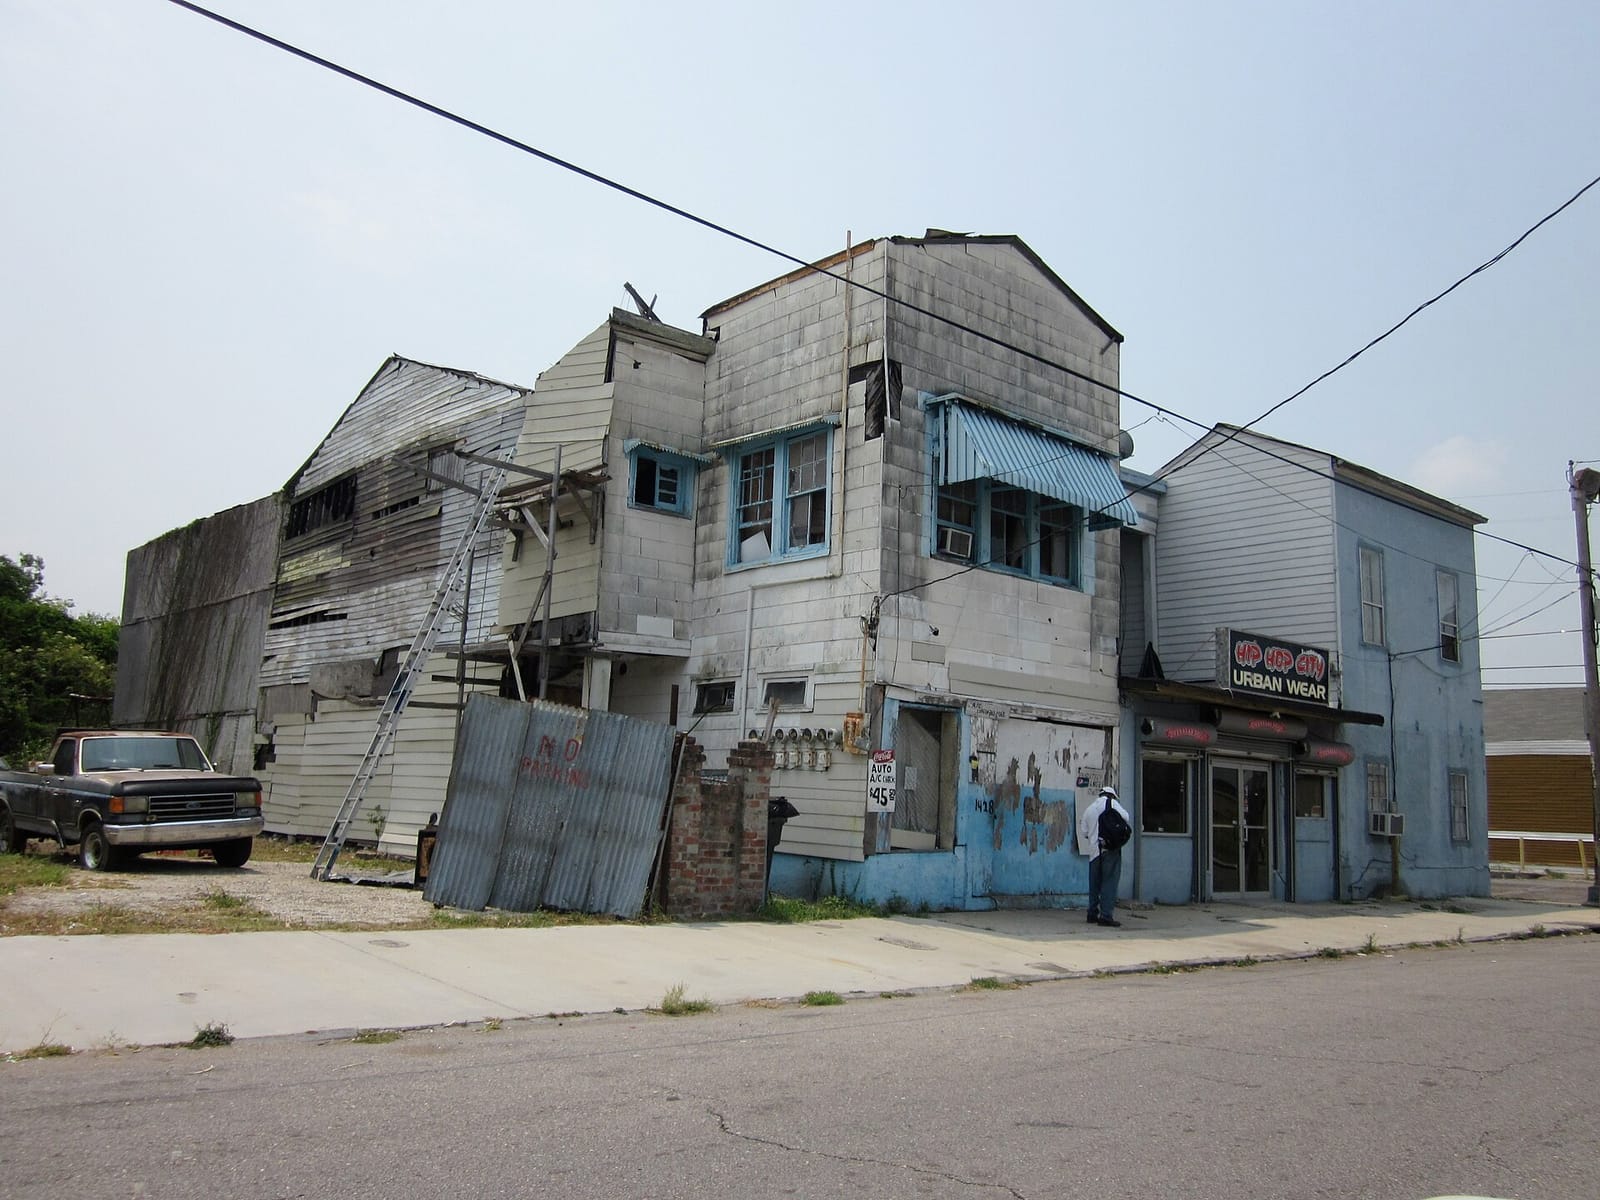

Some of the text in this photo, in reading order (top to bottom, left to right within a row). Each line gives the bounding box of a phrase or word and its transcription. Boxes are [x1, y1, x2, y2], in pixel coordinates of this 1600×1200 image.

[1235, 640, 1325, 681] HIP HOP CITY
[1233, 669, 1326, 700] URBAN WEAR
[539, 734, 580, 762] NO
[869, 774, 882, 783] A/C
[871, 763, 892, 773] AUTO
